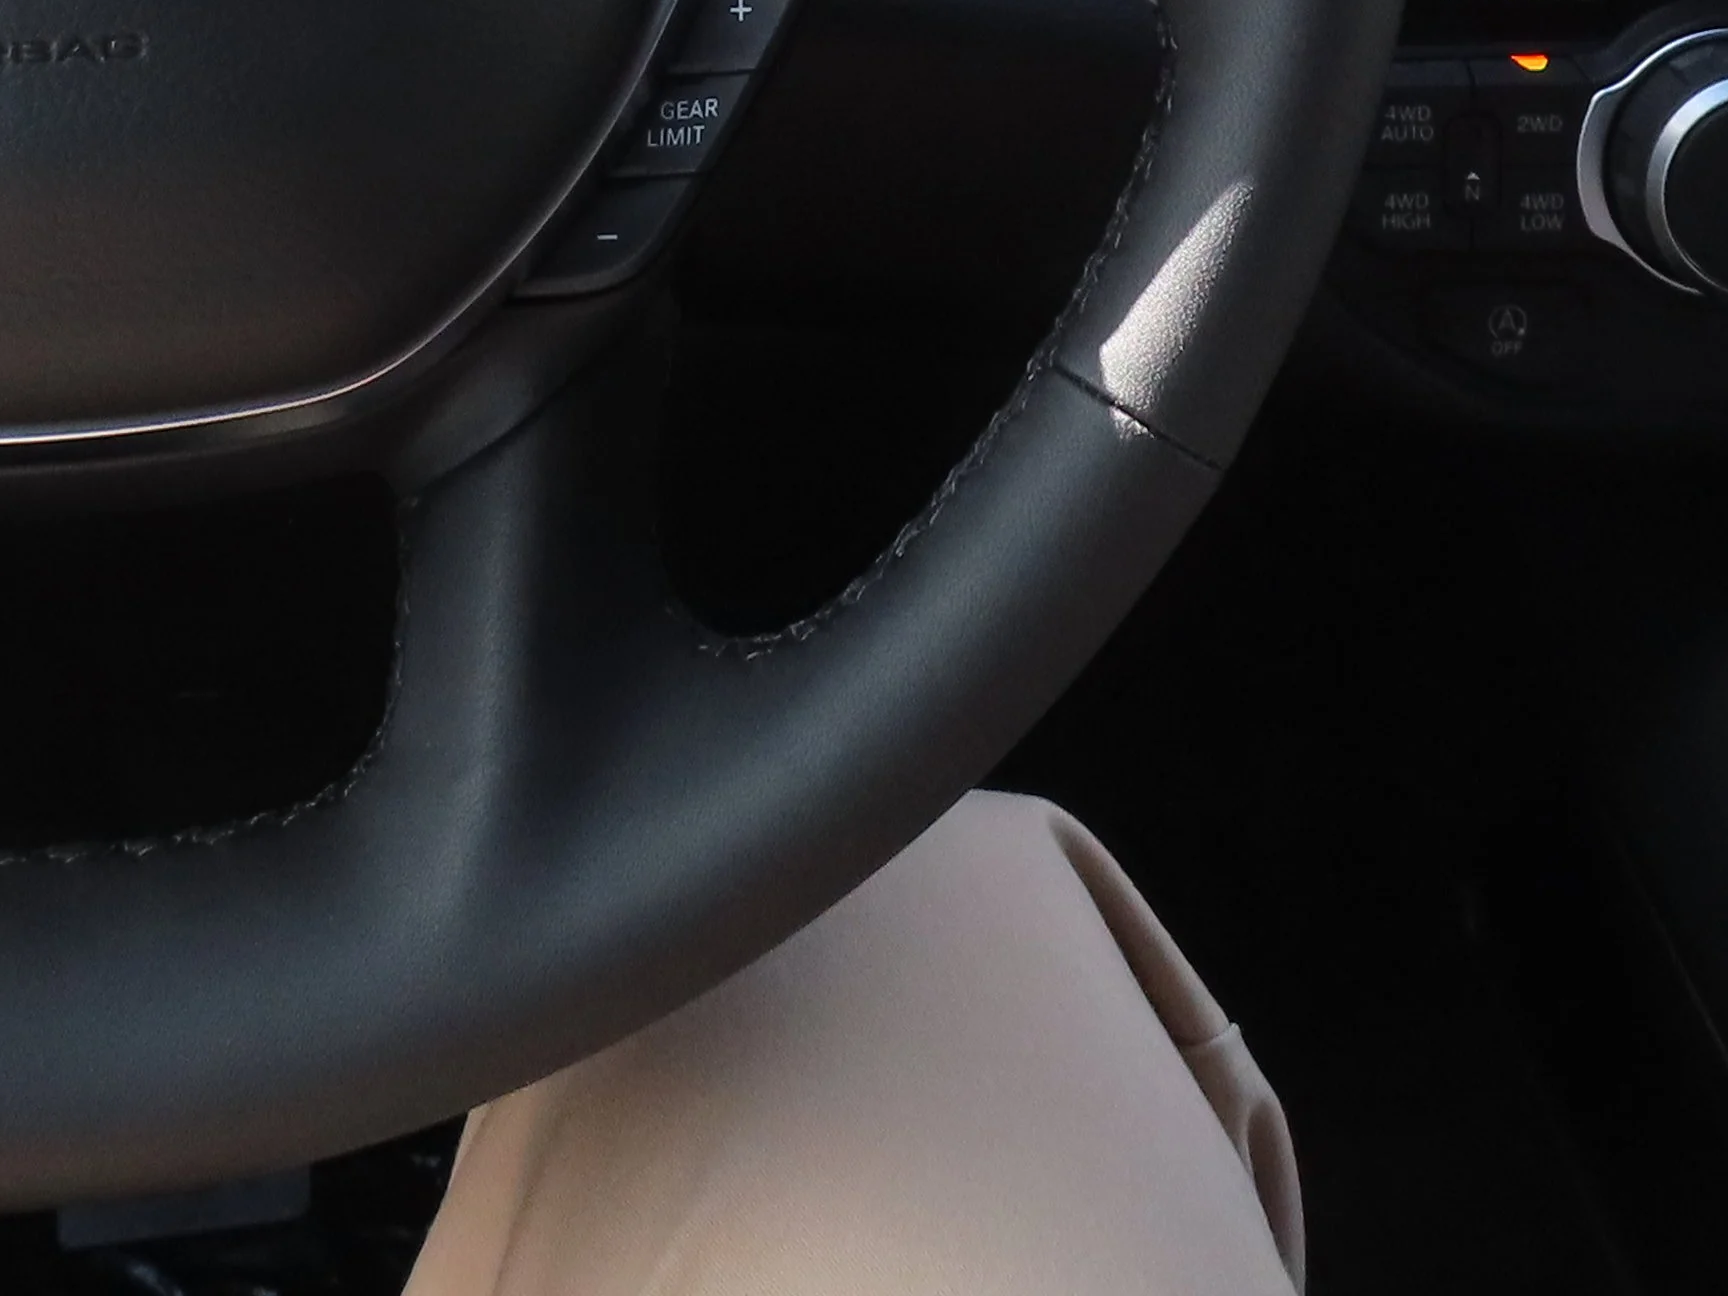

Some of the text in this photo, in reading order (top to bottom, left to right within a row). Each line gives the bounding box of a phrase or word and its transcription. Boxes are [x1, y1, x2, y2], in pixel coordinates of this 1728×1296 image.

[660, 97, 719, 120] GEAR
[1383, 104, 1432, 122] 4WD
[1380, 124, 1435, 142] AUTO
[1516, 115, 1564, 134] 2WD
[647, 125, 705, 148] LIMIT
[1383, 192, 1430, 210] 4WD
[1519, 192, 1565, 210] 4WD
[1380, 213, 1432, 231] HIGH
[1519, 214, 1566, 233] LOW
[1491, 340, 1523, 357] OFF
